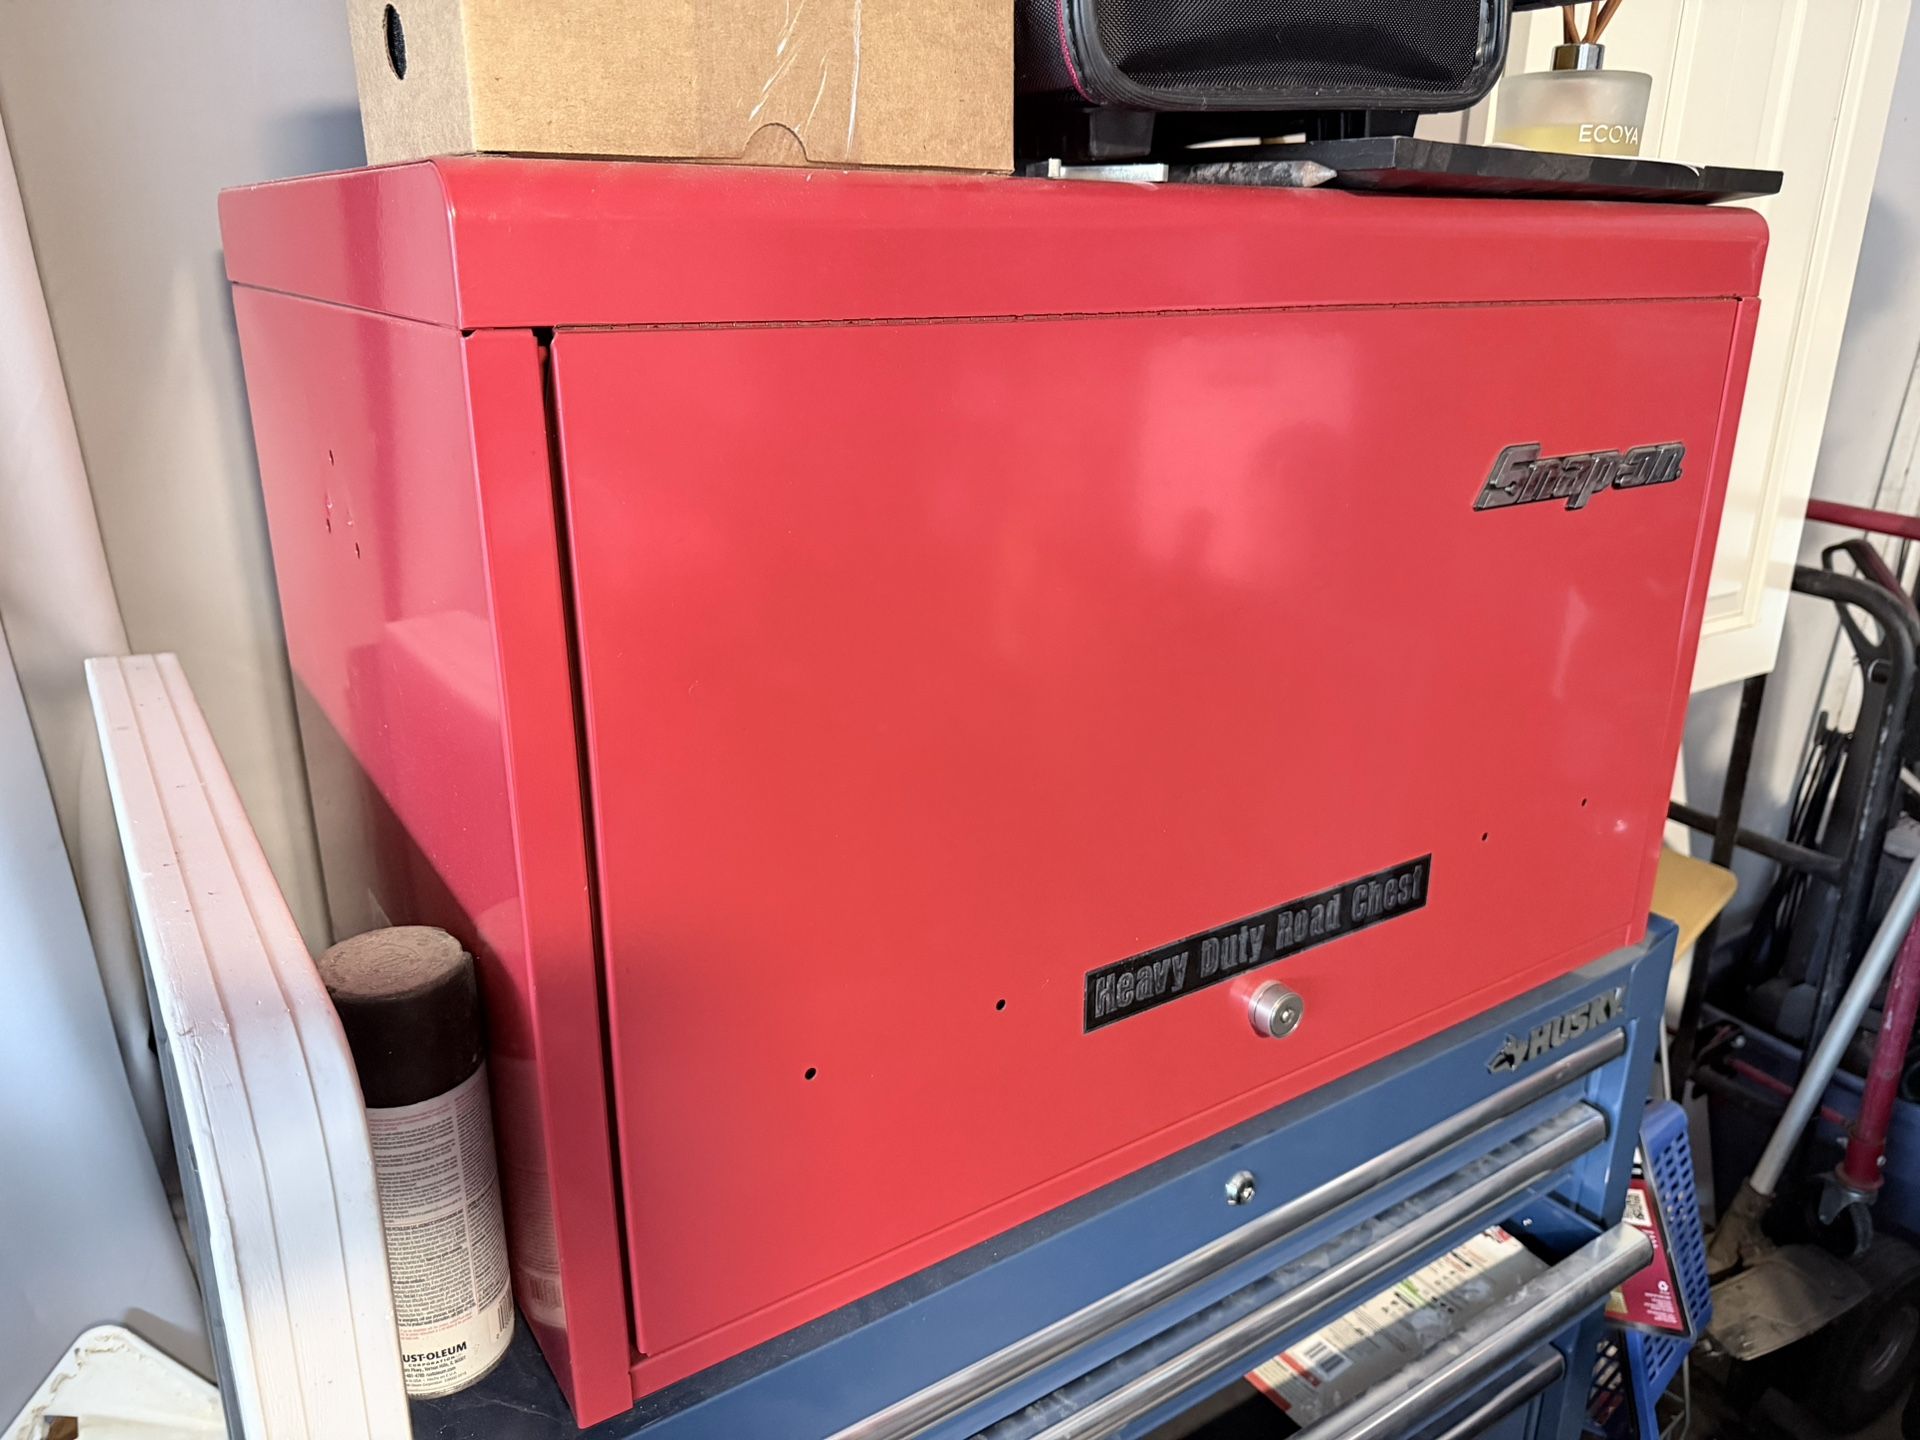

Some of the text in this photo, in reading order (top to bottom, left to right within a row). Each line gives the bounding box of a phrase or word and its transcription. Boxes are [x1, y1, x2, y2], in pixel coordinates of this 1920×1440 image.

[1579, 124, 1638, 145] ECOYA
[1094, 865, 1423, 1018] Heavy Duty Road Chest
[1528, 985, 1624, 1061] HUSKY
[402, 1341, 467, 1363] UST-OLEUM
